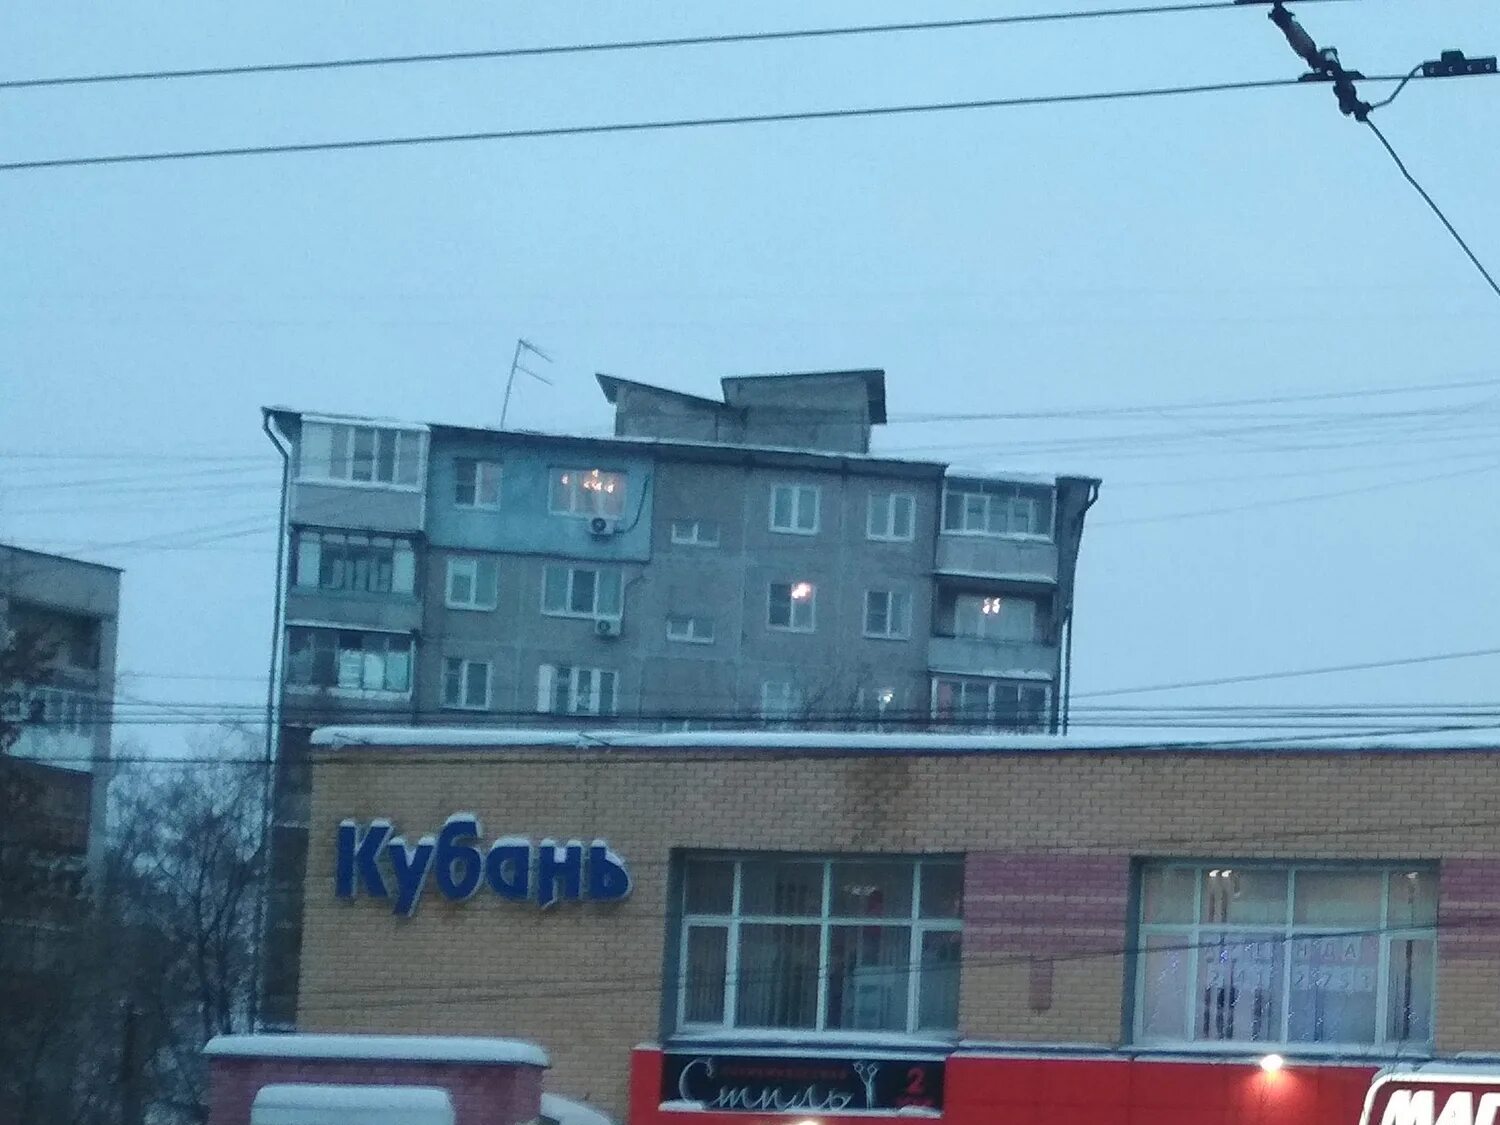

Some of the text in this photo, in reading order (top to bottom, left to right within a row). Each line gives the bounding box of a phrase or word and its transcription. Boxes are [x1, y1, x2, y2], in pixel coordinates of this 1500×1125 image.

[334, 812, 633, 917] Кубань
[678, 1057, 852, 1112] Стиль
[906, 1067, 926, 1095] 2
